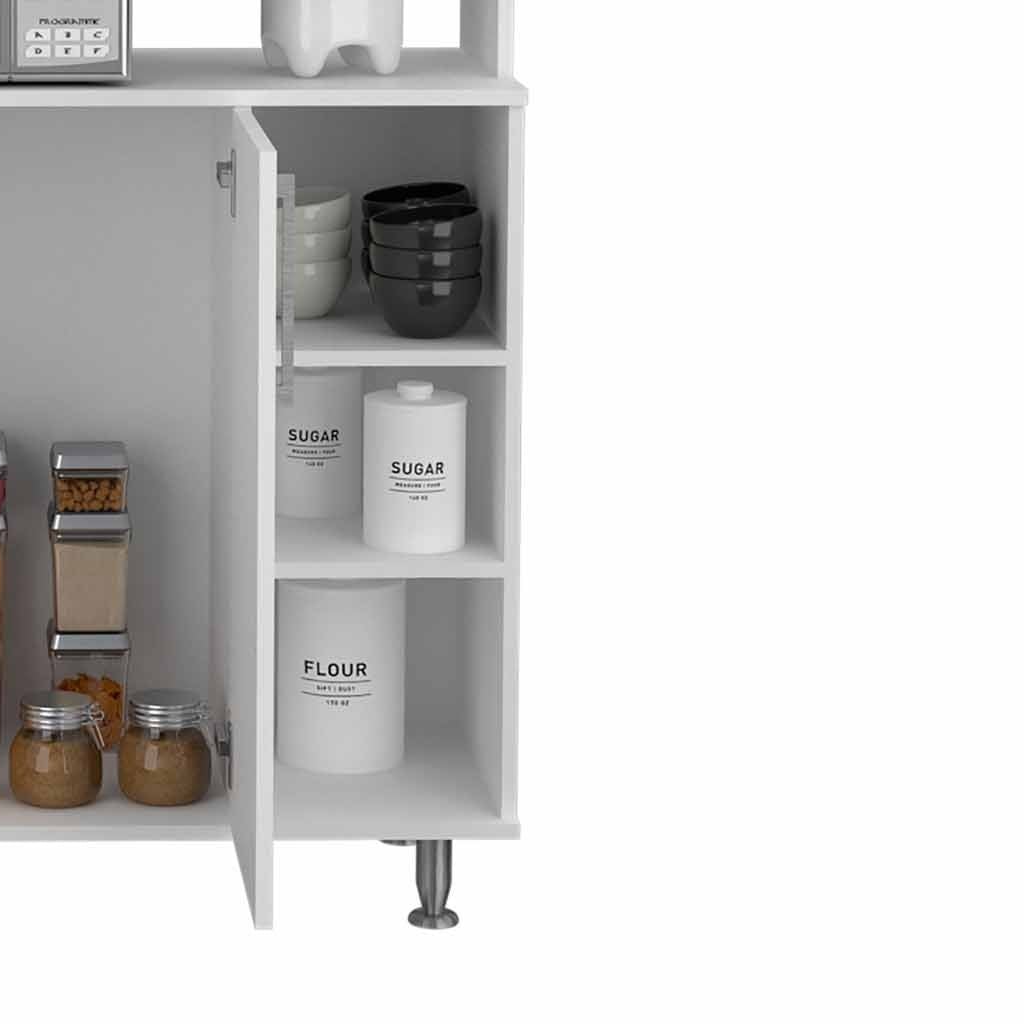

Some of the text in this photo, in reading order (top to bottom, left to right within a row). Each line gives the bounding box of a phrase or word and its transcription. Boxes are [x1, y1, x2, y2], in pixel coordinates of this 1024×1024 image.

[34, 47, 42, 55] D
[93, 47, 101, 55] F
[288, 428, 340, 442] SUGAR
[391, 461, 444, 476] SUGAR
[304, 660, 367, 677] FLOUR
